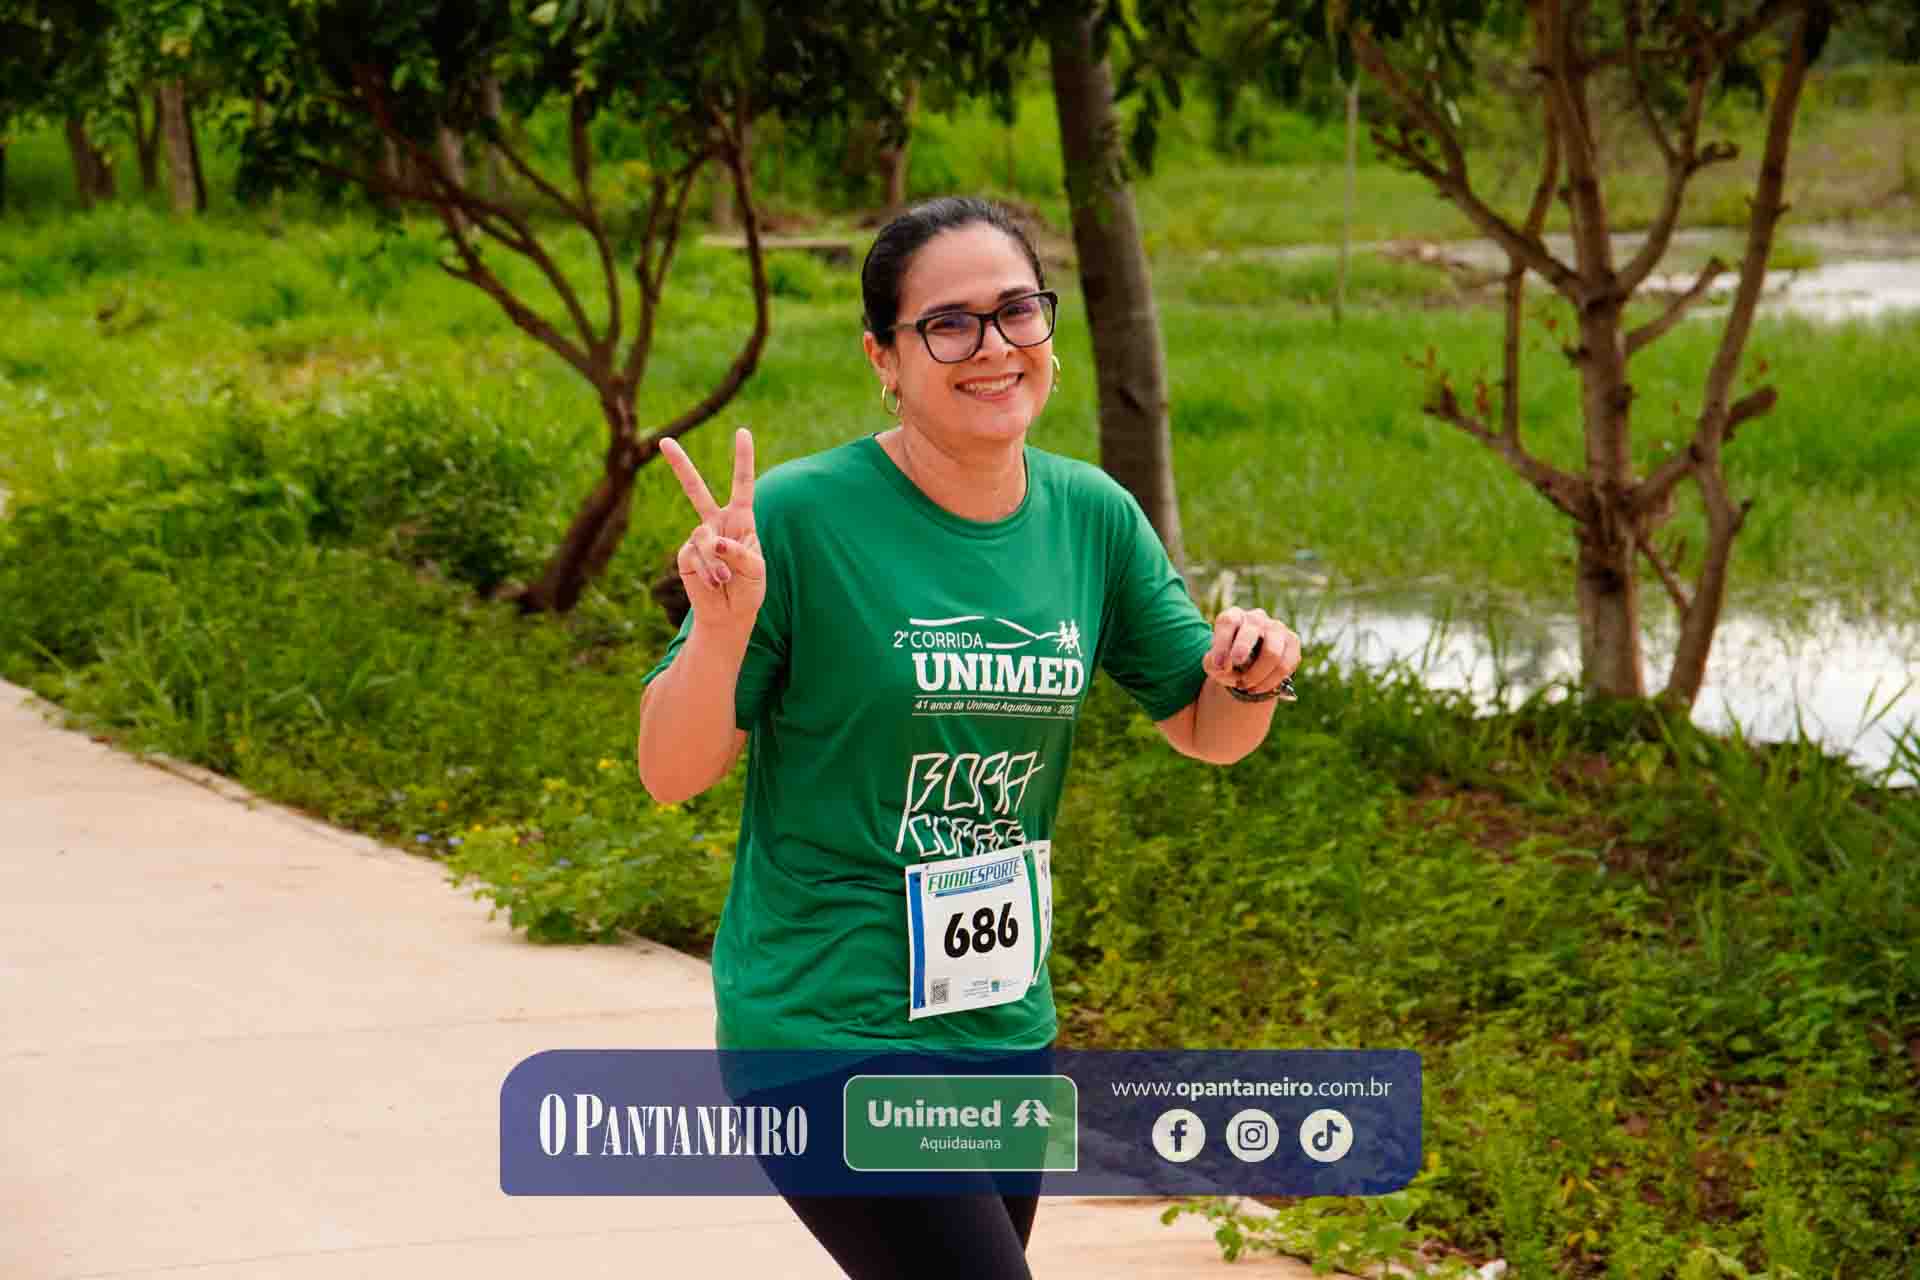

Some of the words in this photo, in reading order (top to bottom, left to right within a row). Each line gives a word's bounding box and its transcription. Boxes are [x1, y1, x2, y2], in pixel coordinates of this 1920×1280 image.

[911, 631, 984, 649] CORRIDA
[912, 652, 1084, 697] UNIMED
[915, 700, 929, 710] 41
[930, 702, 953, 711] anos
[966, 700, 1000, 712] Unimed
[1000, 702, 1052, 714] Aquidauana
[928, 859, 1020, 892] FUNDESPORTE
[944, 902, 1018, 958] 686
